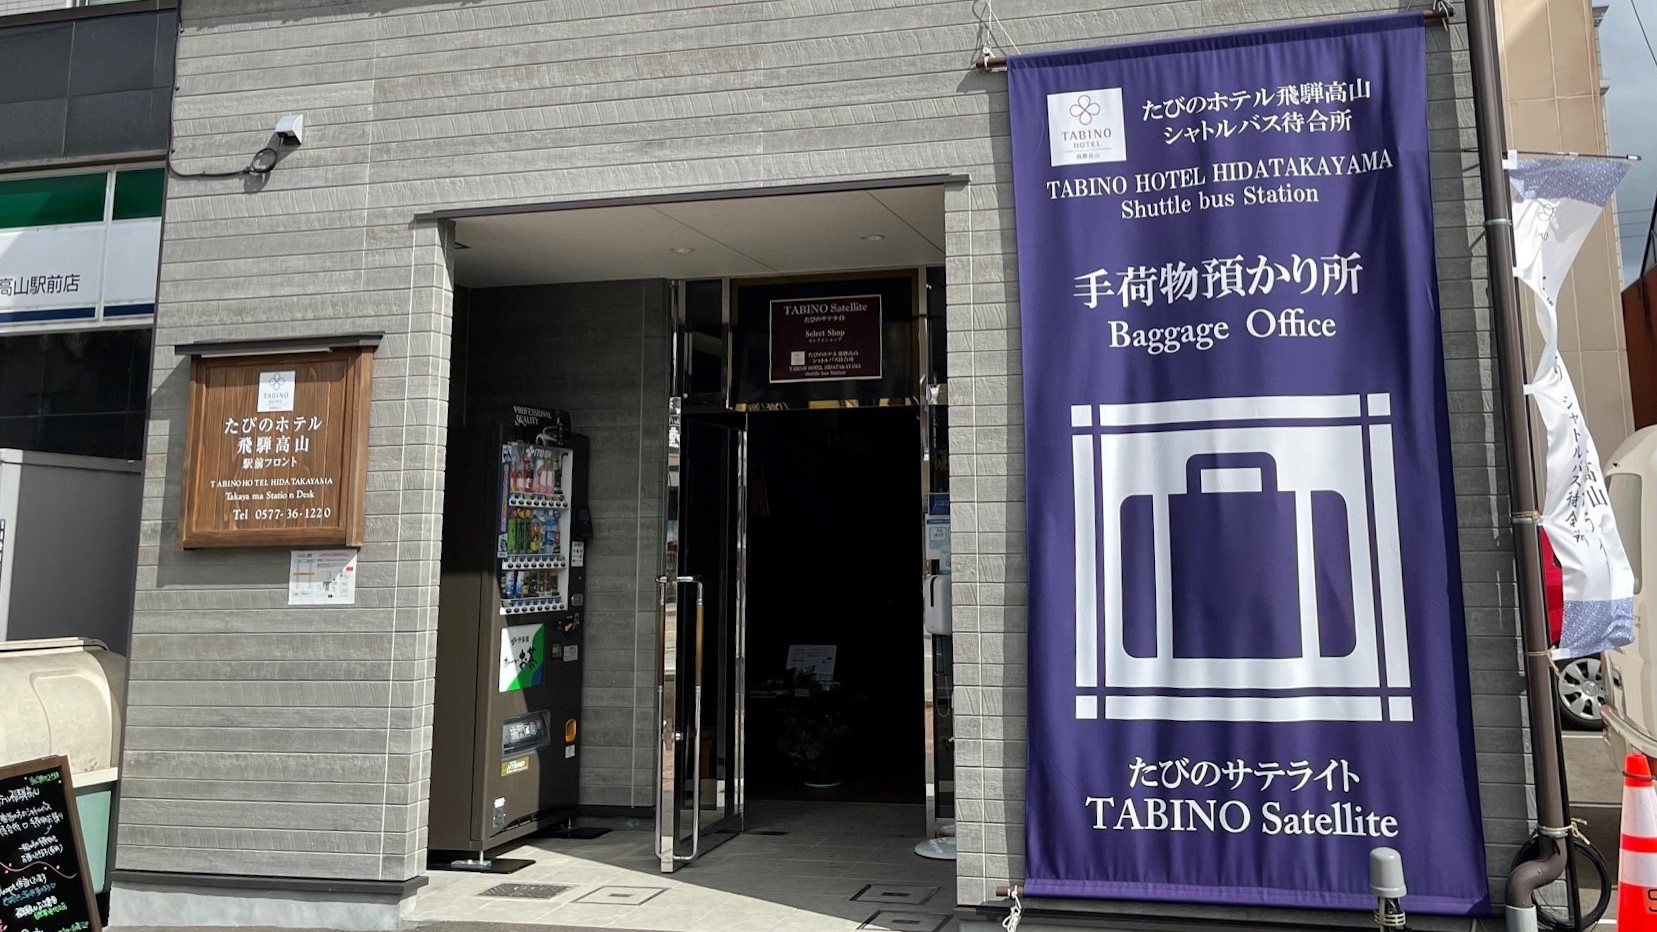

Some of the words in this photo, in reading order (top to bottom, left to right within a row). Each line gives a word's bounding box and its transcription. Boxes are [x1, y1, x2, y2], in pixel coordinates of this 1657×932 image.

[1141, 78, 1372, 122] たびのホテル飛騨高山
[1061, 127, 1112, 141] TABINO
[1162, 109, 1353, 145] シャトルバス待合所
[1073, 141, 1101, 149] HOTEL
[1046, 176, 1128, 200] TABINO
[1135, 168, 1206, 191] HOTEL
[1212, 149, 1394, 181] HIDATAKAYAMA
[1121, 195, 1192, 219] Shuttle
[1199, 189, 1235, 209] bus
[1243, 184, 1319, 206] Station
[1073, 252, 1363, 309] 手荷物預かり所
[783, 304, 828, 316] TABINO
[830, 302, 868, 312] Satellite
[805, 329, 825, 338] Select
[827, 328, 845, 338] Shop
[1108, 319, 1229, 355] Baggage
[1246, 307, 1337, 338] Office
[513, 405, 552, 419] PROFESSIONAL
[514, 415, 539, 427] QUALITY
[224, 416, 323, 434] たびのホテル
[237, 436, 310, 454] 飛騨高山
[242, 456, 298, 469] 駅前フロント
[225, 491, 264, 502] Takayama
[266, 489, 295, 500] Station
[296, 490, 315, 499] Desk
[233, 508, 248, 521] Tel
[255, 507, 331, 519] 0577-36-1220
[1128, 756, 1360, 793] たびのサテライト
[1085, 796, 1251, 833] TABINO
[1261, 801, 1398, 838] Satellite
